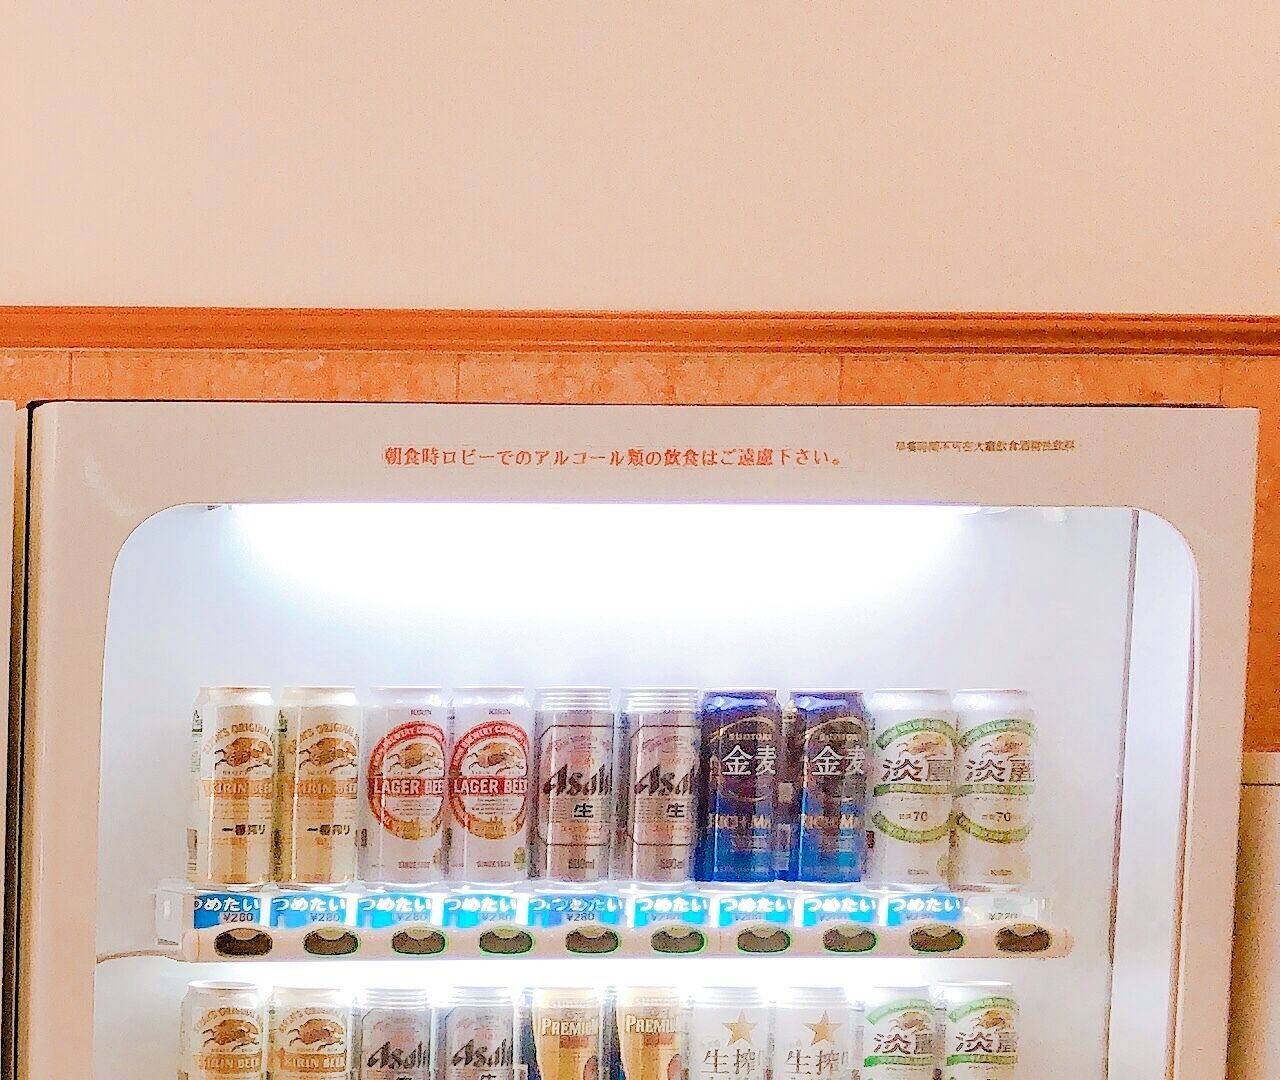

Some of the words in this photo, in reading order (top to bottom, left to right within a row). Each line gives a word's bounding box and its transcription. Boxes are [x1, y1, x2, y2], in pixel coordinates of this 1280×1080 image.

[384, 446, 843, 467] 朝食時ロビーでのアルコール類の飲食はご遠慮下さい。
[721, 745, 777, 776] 金麦
[811, 745, 865, 776] 金麦
[374, 778, 420, 795] LAGER
[454, 778, 500, 795] LAGER
[573, 803, 594, 818] 生
[667, 803, 685, 818] 生
[273, 898, 346, 913] つめたい
[360, 898, 431, 913] つめたい
[806, 898, 877, 912] つめたい
[891, 898, 961, 912] つめたい
[223, 912, 253, 922] ¥280
[367, 1042, 429, 1069] Asahi
